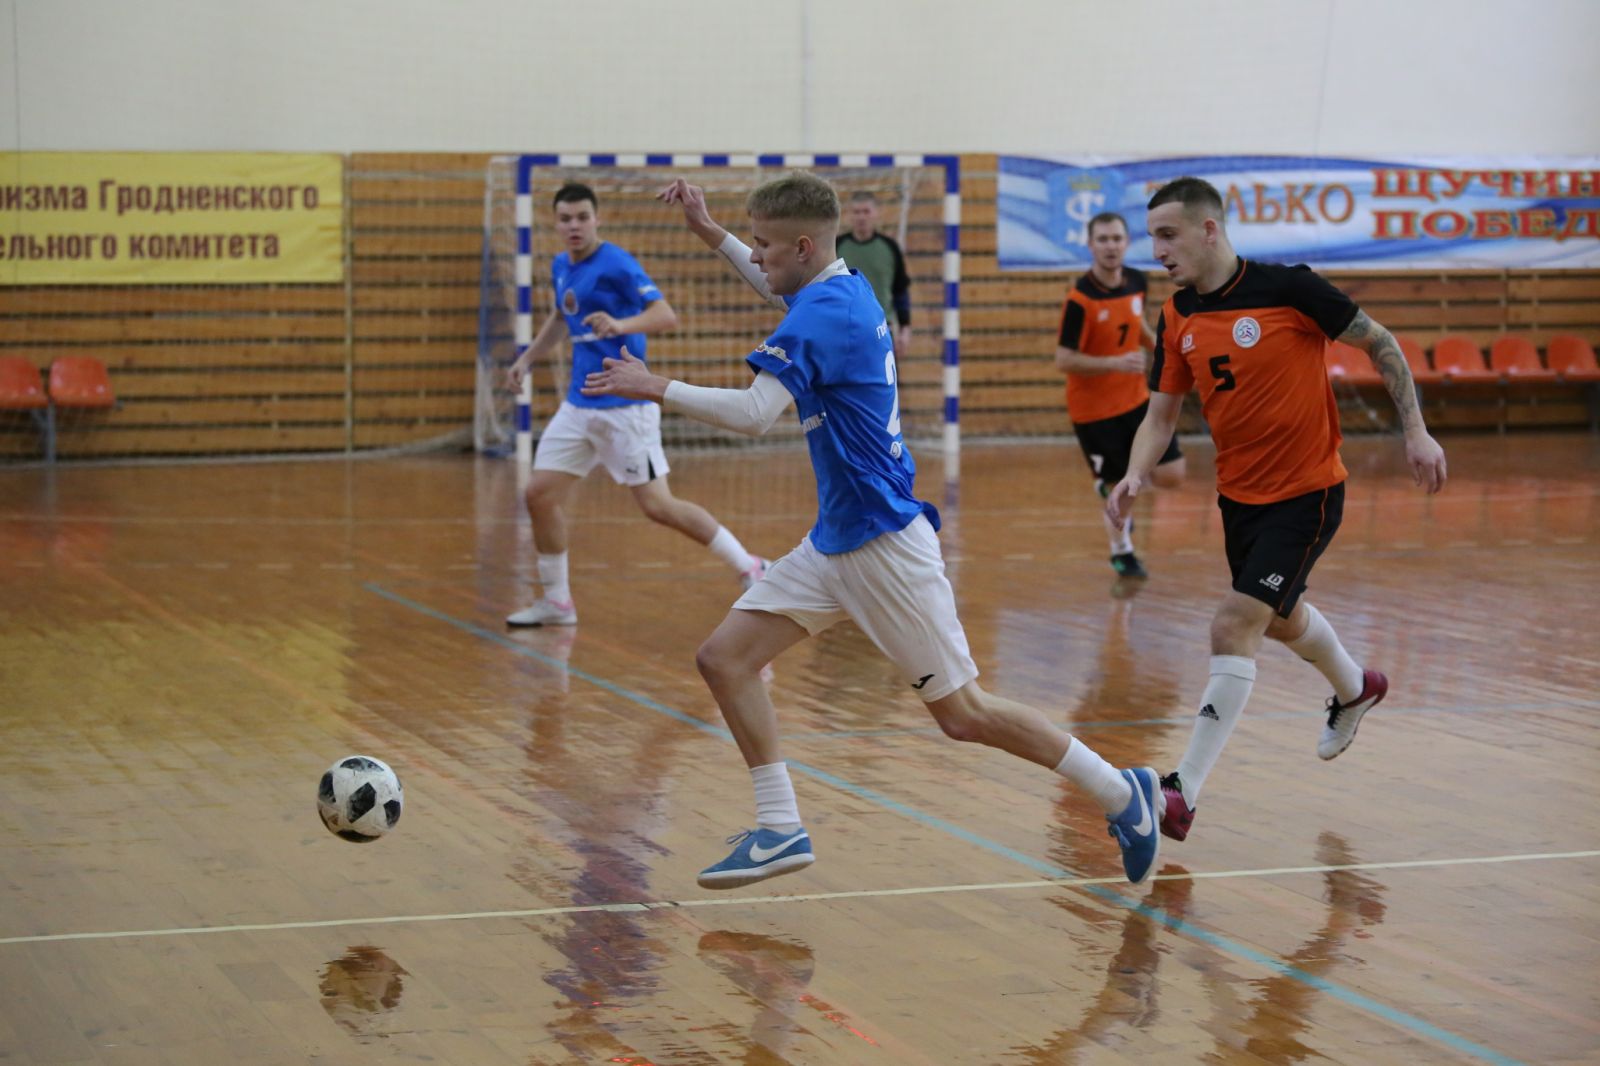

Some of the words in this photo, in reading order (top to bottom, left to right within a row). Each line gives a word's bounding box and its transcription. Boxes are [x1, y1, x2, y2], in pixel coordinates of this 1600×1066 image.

[99, 179, 319, 215] Гродненского
[1371, 209, 1600, 242] ПОБЕД
[129, 234, 280, 259] комитета
[1209, 355, 1236, 392] 5
